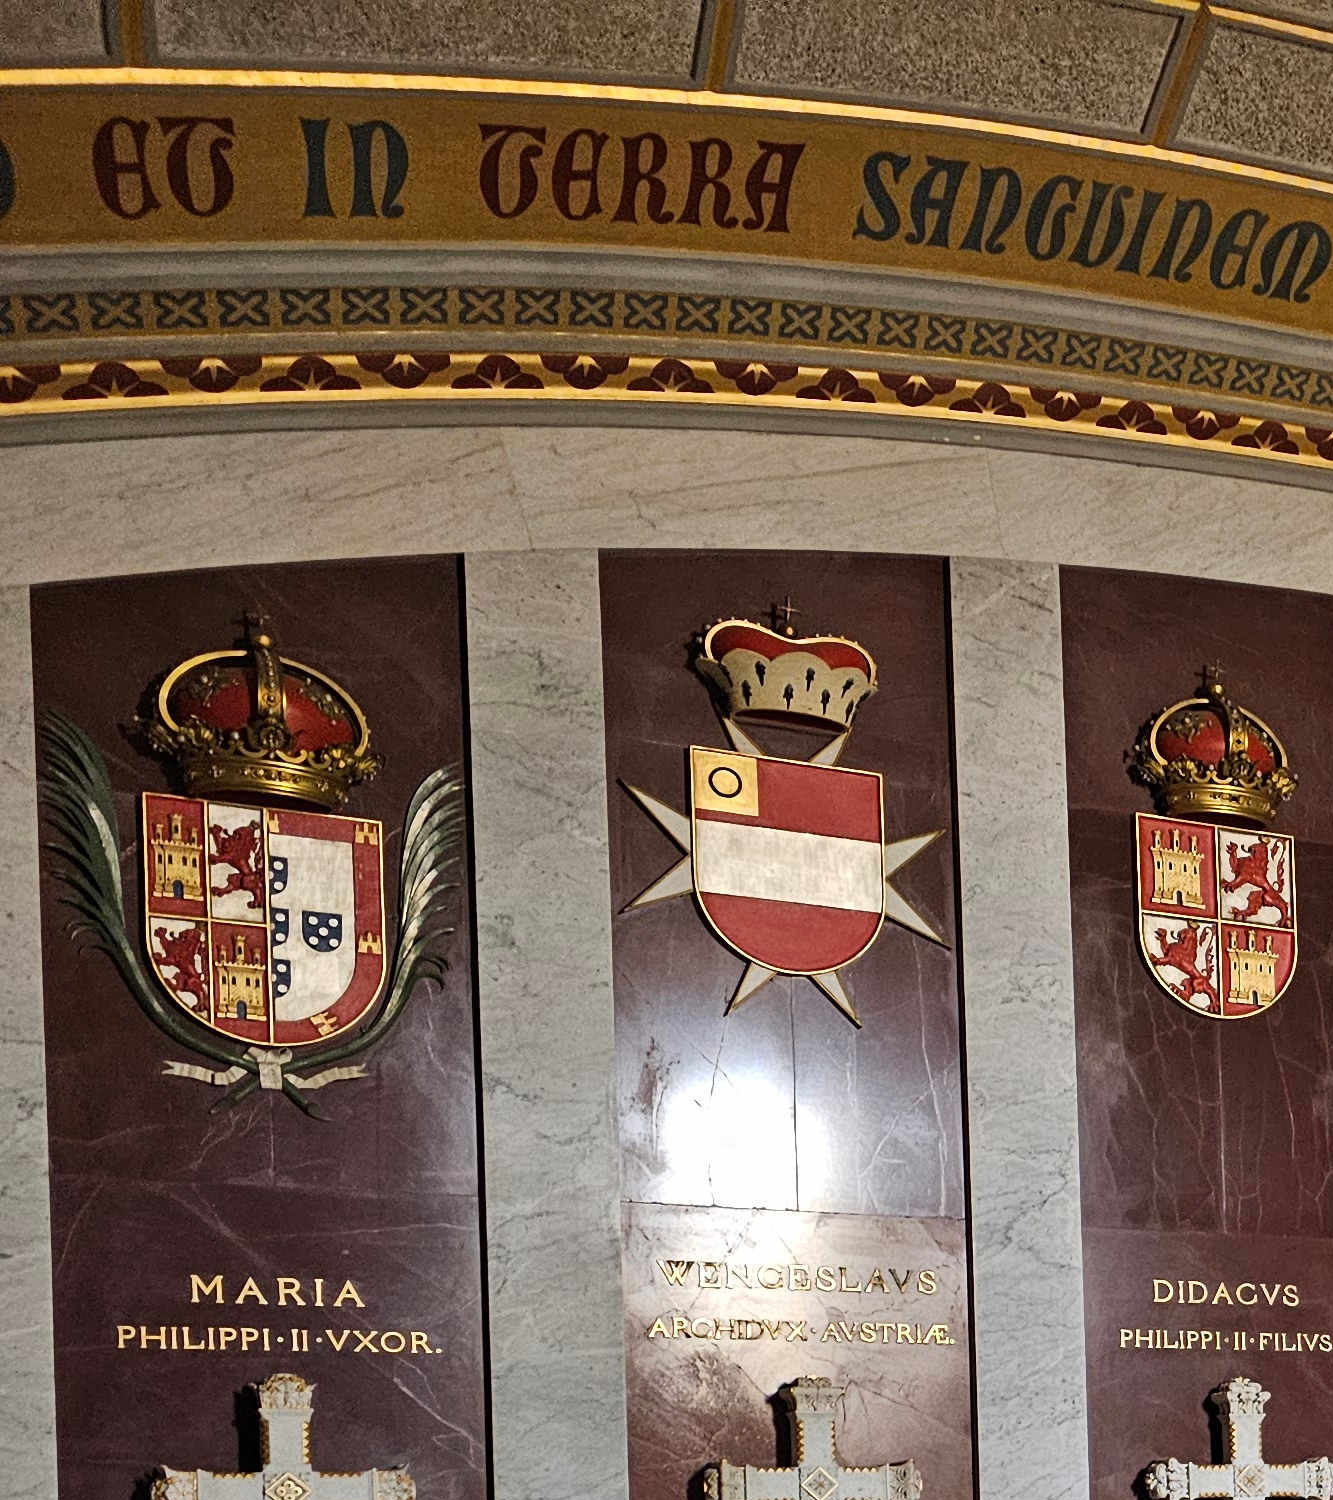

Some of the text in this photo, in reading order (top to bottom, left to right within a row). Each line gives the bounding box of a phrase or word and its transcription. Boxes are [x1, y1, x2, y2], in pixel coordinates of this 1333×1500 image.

[92, 116, 235, 220] ET
[299, 117, 409, 219] IN
[478, 122, 807, 234] TERRA
[190, 1274, 368, 1308] MARIA
[655, 1259, 938, 1295] WENCESLAVS
[1152, 1278, 1300, 1307] DIDACVS
